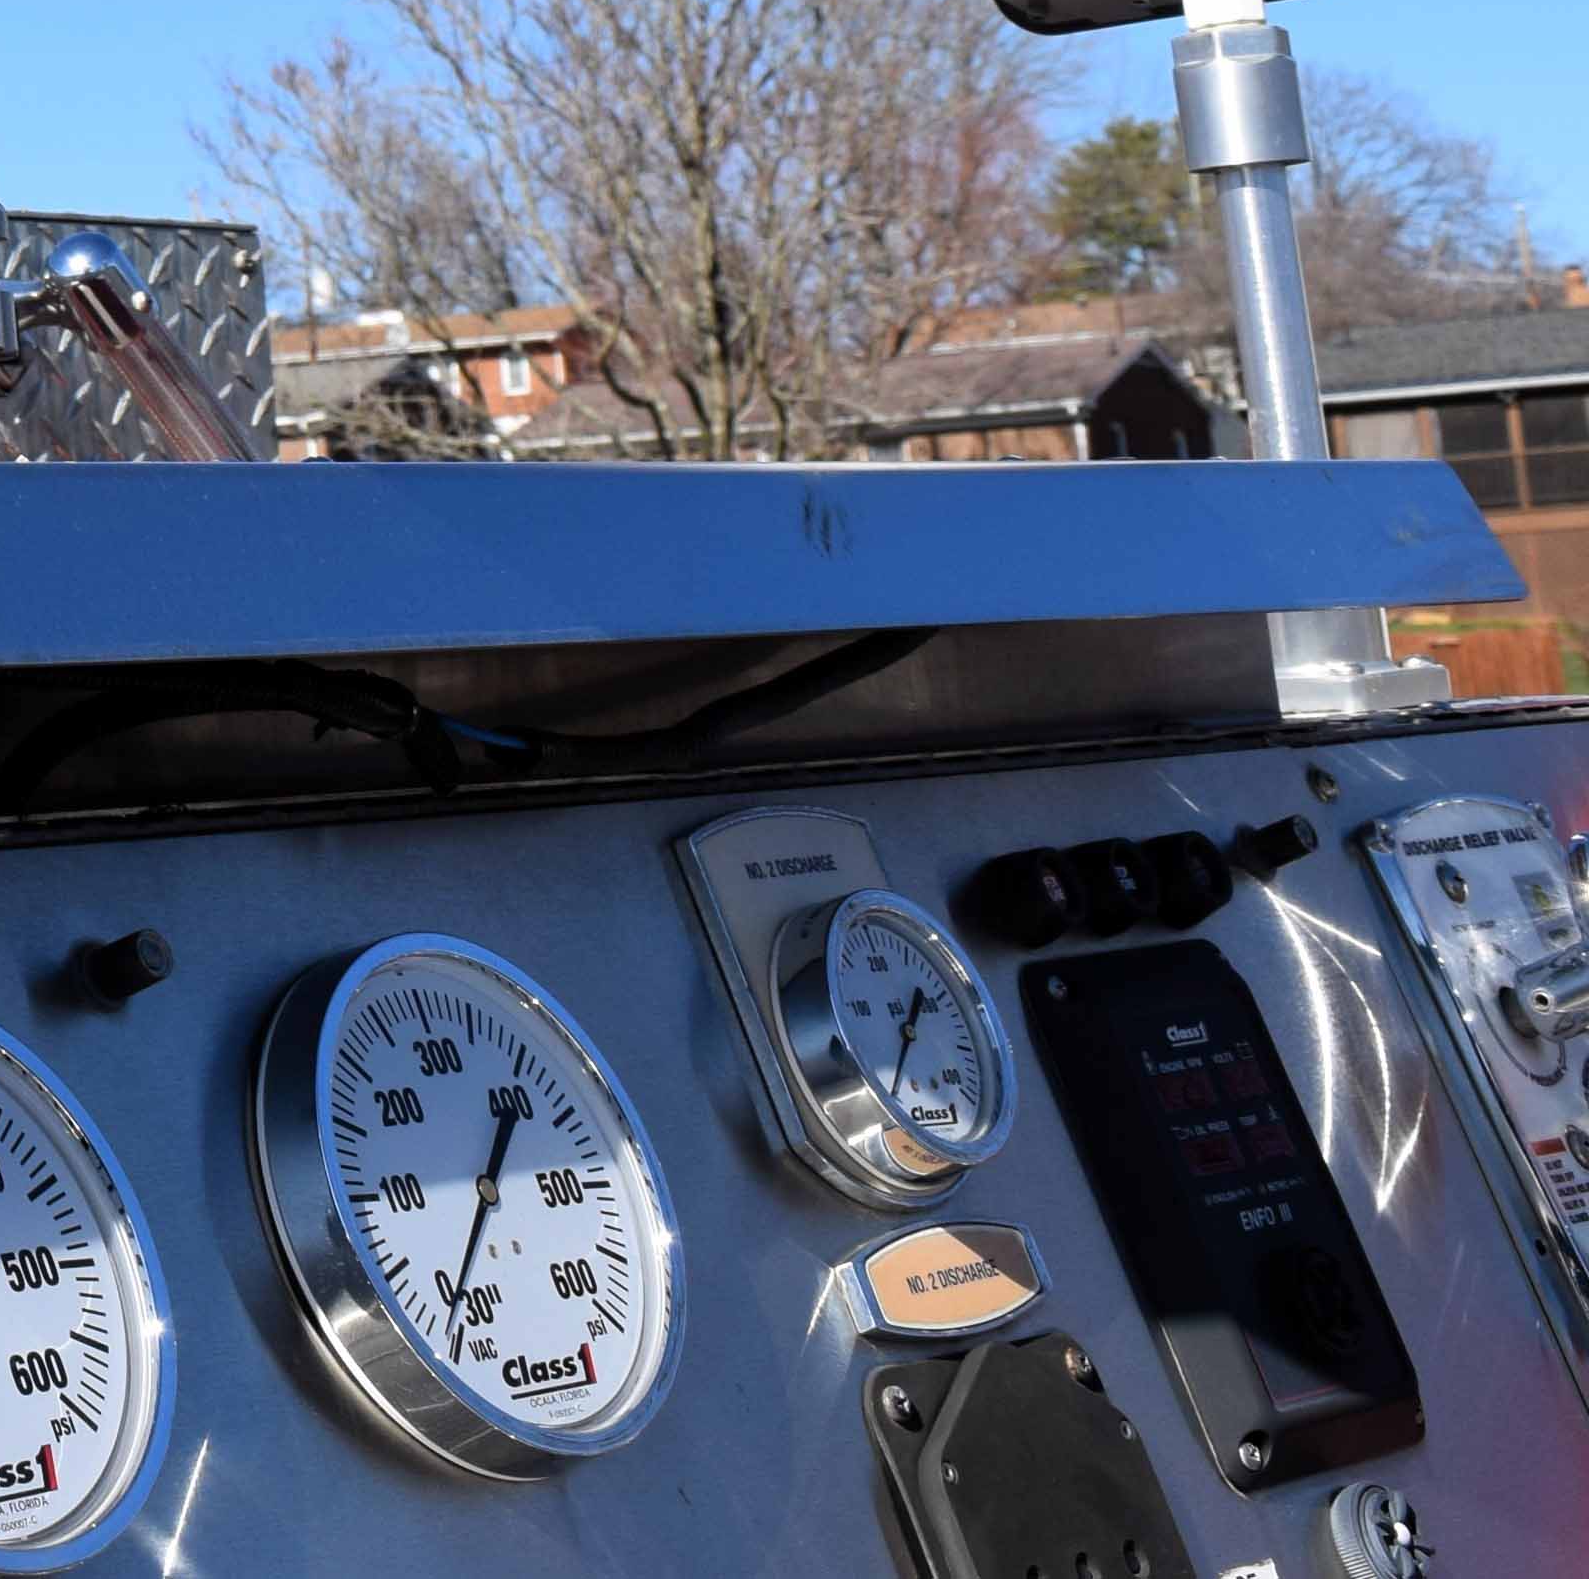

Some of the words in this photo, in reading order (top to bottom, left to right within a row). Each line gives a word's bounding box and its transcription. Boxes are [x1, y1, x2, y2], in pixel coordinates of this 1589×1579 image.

[1402, 835, 1464, 856] DISCHARGE
[1463, 830, 1502, 849] RELIEF
[1502, 826, 1539, 844] VALVE
[744, 860, 767, 880] NO.
[766, 860, 777, 878] 2
[776, 853, 838, 877] DISCHARGE
[867, 955, 889, 973] 200
[886, 997, 906, 1019] psi
[413, 1037, 463, 1077] 300
[943, 1068, 962, 1086] 400
[374, 1087, 422, 1128] 200
[489, 1084, 533, 1121] 400
[379, 1172, 426, 1213] 100
[535, 1167, 584, 1208] 500
[1, 1246, 60, 1293] 500
[549, 1258, 598, 1300] 600
[906, 1273, 929, 1295] NO.
[929, 1271, 939, 1291] 2
[938, 1259, 999, 1288] DISCHARGE
[434, 1269, 455, 1308] 0
[586, 1313, 609, 1342] psi
[468, 1337, 499, 1363] VAC
[10, 1347, 68, 1396] 600
[50, 1410, 77, 1443] psi
[9, 1496, 49, 1513] FLORIDA
